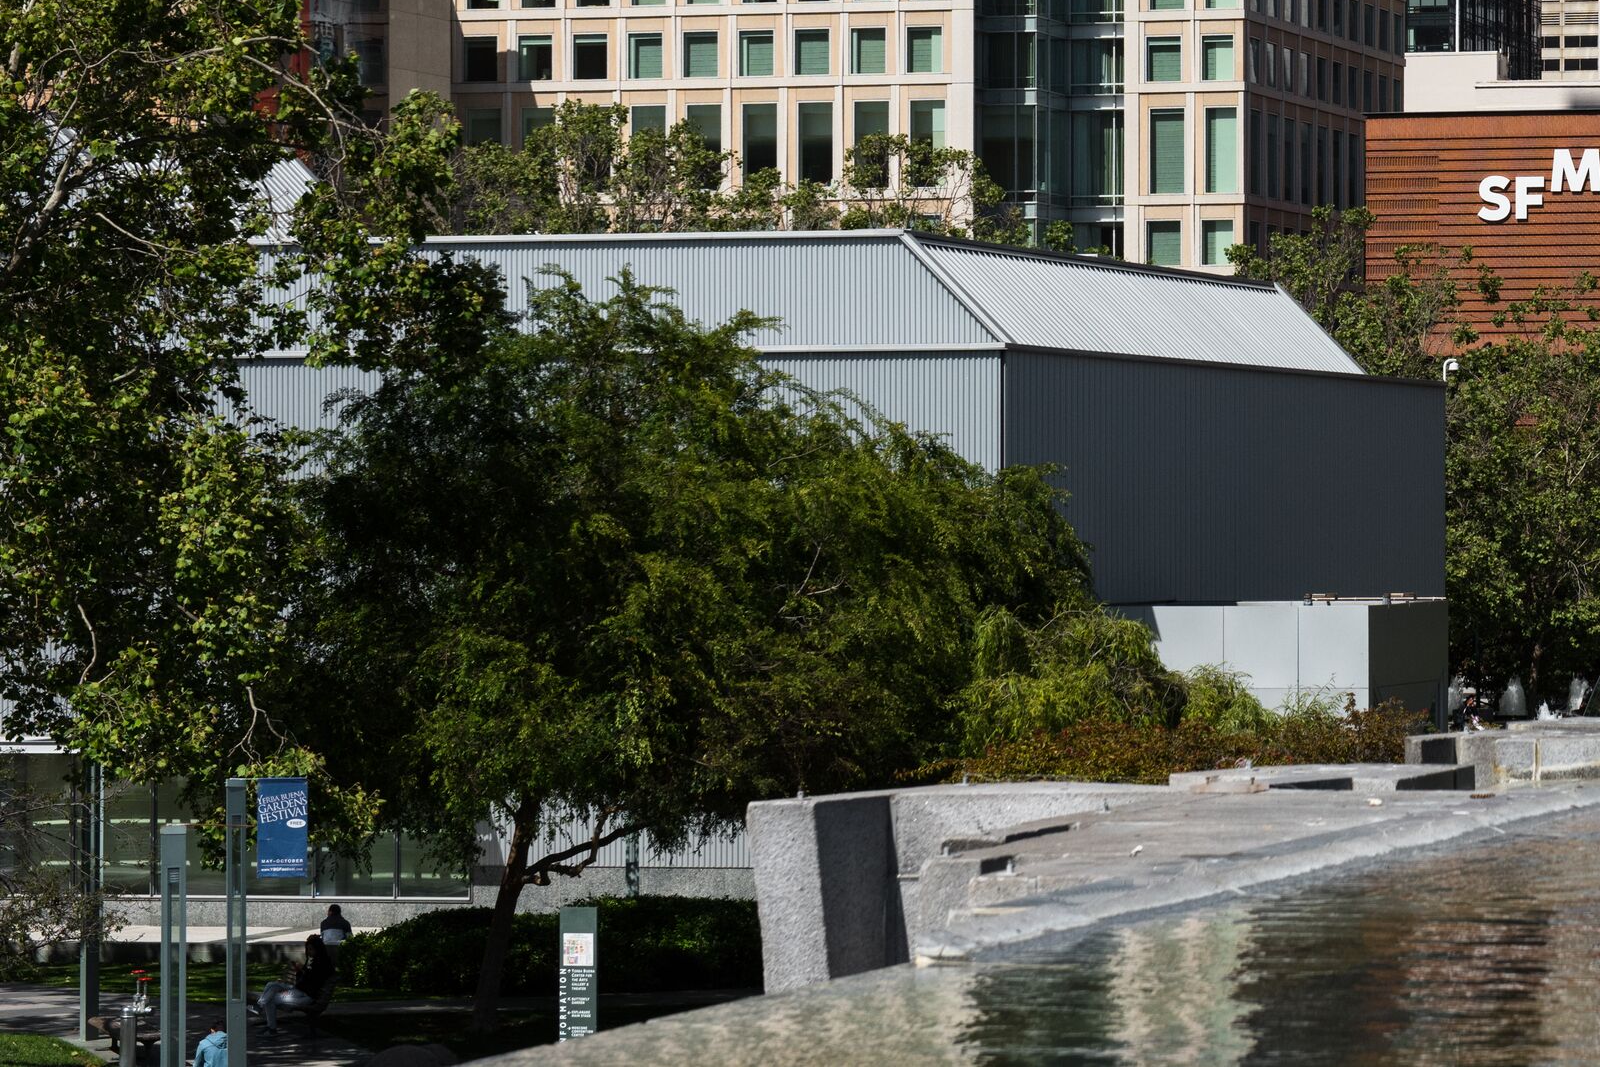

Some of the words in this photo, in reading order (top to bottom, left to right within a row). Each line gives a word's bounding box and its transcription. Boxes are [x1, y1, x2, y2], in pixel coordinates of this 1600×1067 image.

[1477, 175, 1545, 222] SF
[258, 794, 280, 805] YERBA
[281, 790, 306, 800] BUENA
[258, 797, 307, 813] GARDENS
[260, 805, 308, 823] FESTIVAL
[559, 968, 567, 1043] NFORMATION
